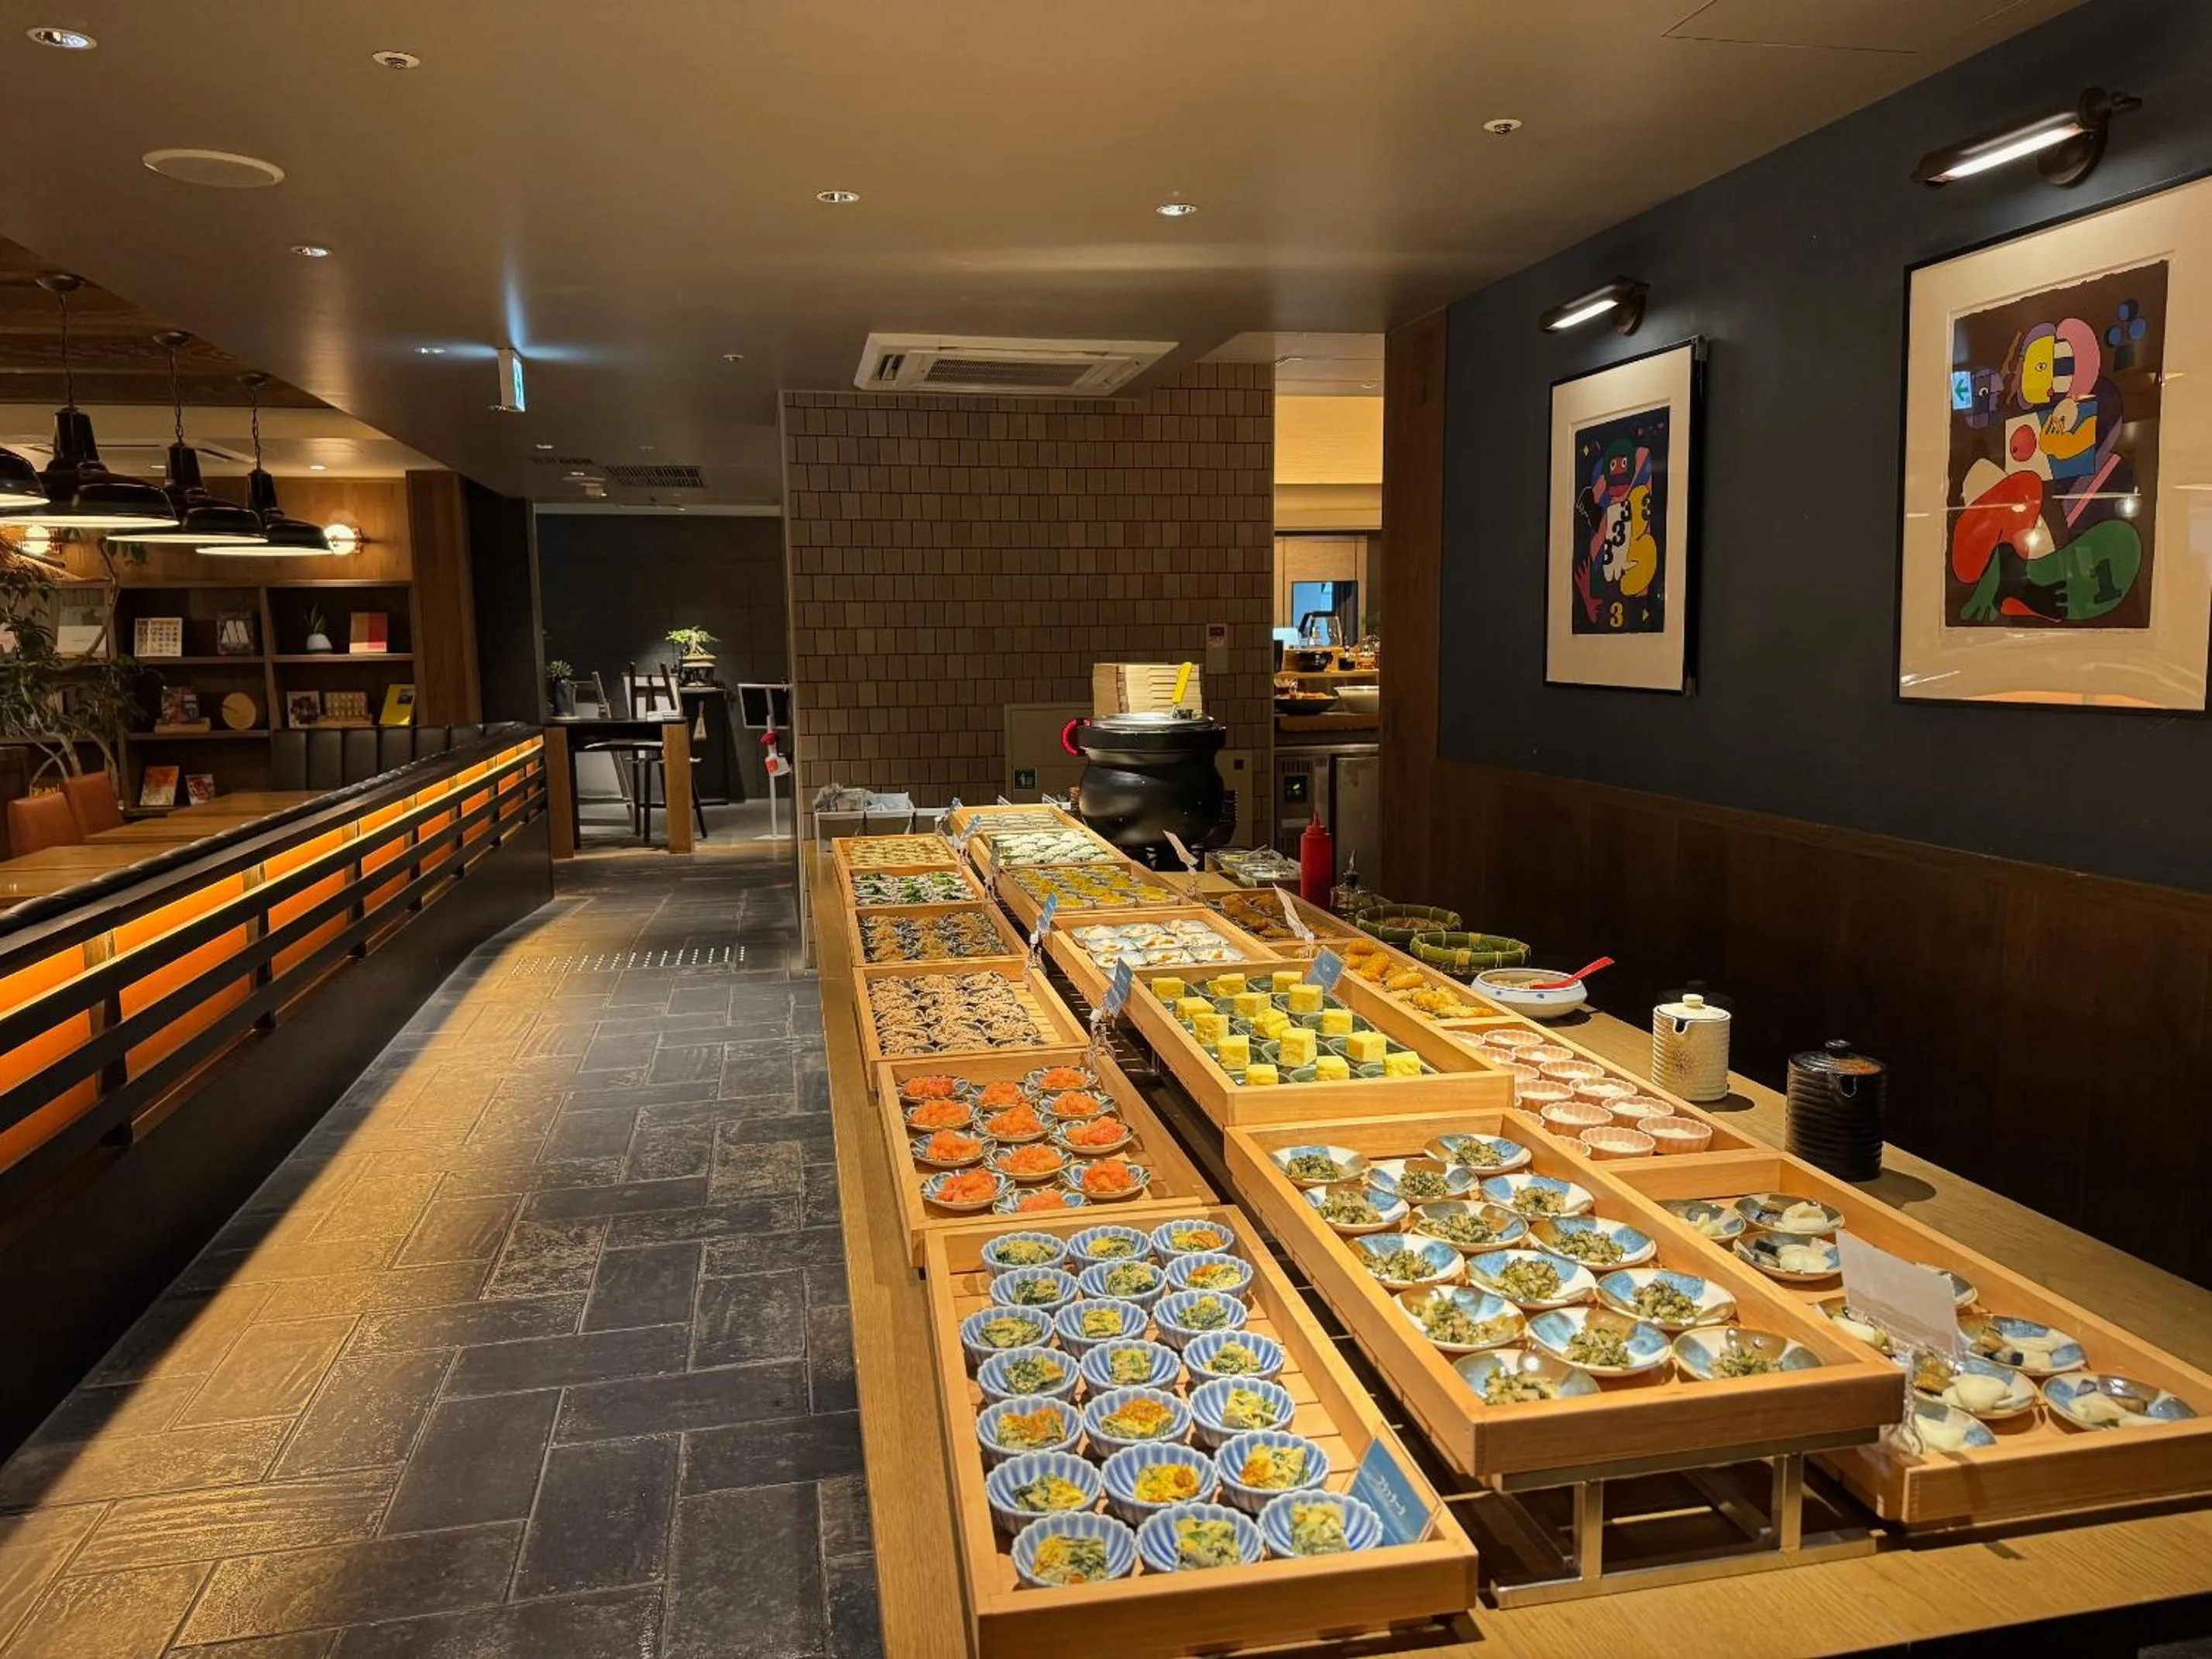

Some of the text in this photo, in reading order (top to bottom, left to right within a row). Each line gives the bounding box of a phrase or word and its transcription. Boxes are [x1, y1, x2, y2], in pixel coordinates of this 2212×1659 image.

[1612, 520, 1626, 547] 3
[2090, 558, 2122, 604] 1
[1609, 602, 1623, 627] 3
